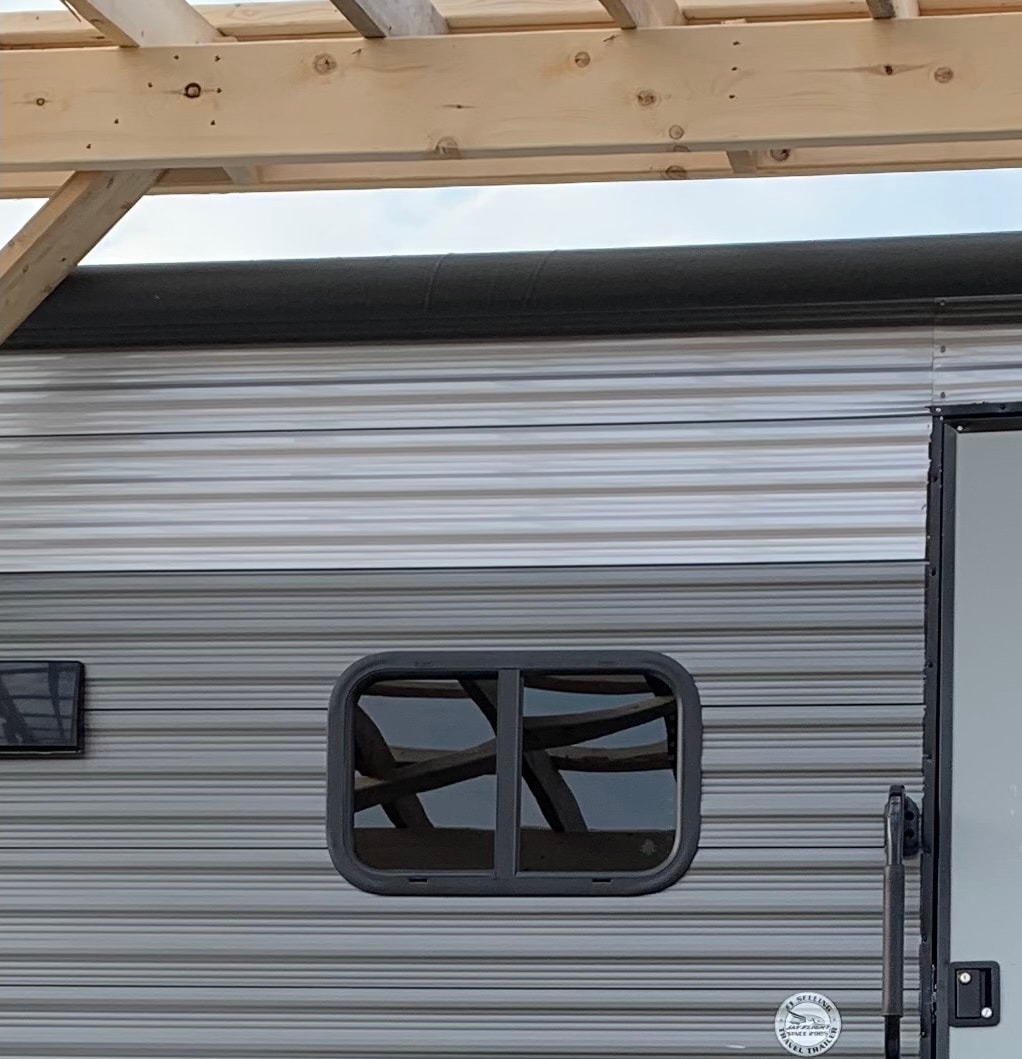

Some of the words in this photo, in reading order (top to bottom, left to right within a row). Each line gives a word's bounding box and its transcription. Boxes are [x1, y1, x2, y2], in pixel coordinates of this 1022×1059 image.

[796, 995, 832, 1012] SELLING
[779, 1027, 803, 1054] TRAVEL
[808, 1027, 838, 1054] TRAILER
